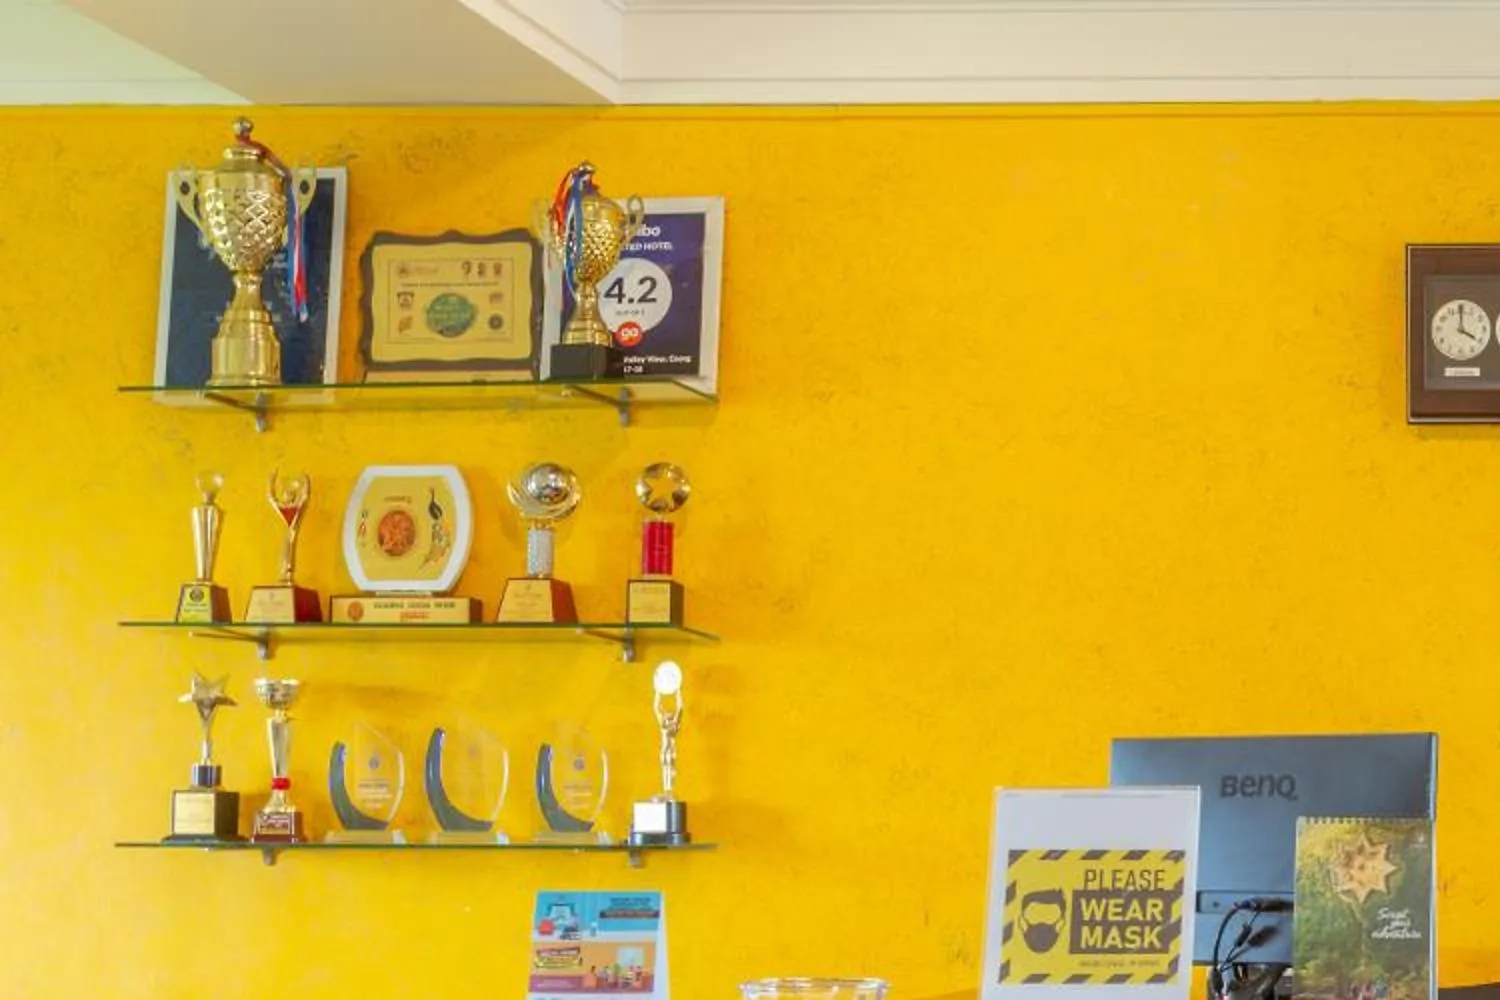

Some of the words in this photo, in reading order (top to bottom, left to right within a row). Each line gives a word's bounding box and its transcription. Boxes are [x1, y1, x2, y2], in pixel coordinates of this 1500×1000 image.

[603, 275, 658, 305] 4.2
[1220, 773, 1299, 801] BenQ
[1083, 868, 1166, 891] PLEASE
[1080, 898, 1164, 921] WEAR
[1080, 925, 1162, 949] MASK
